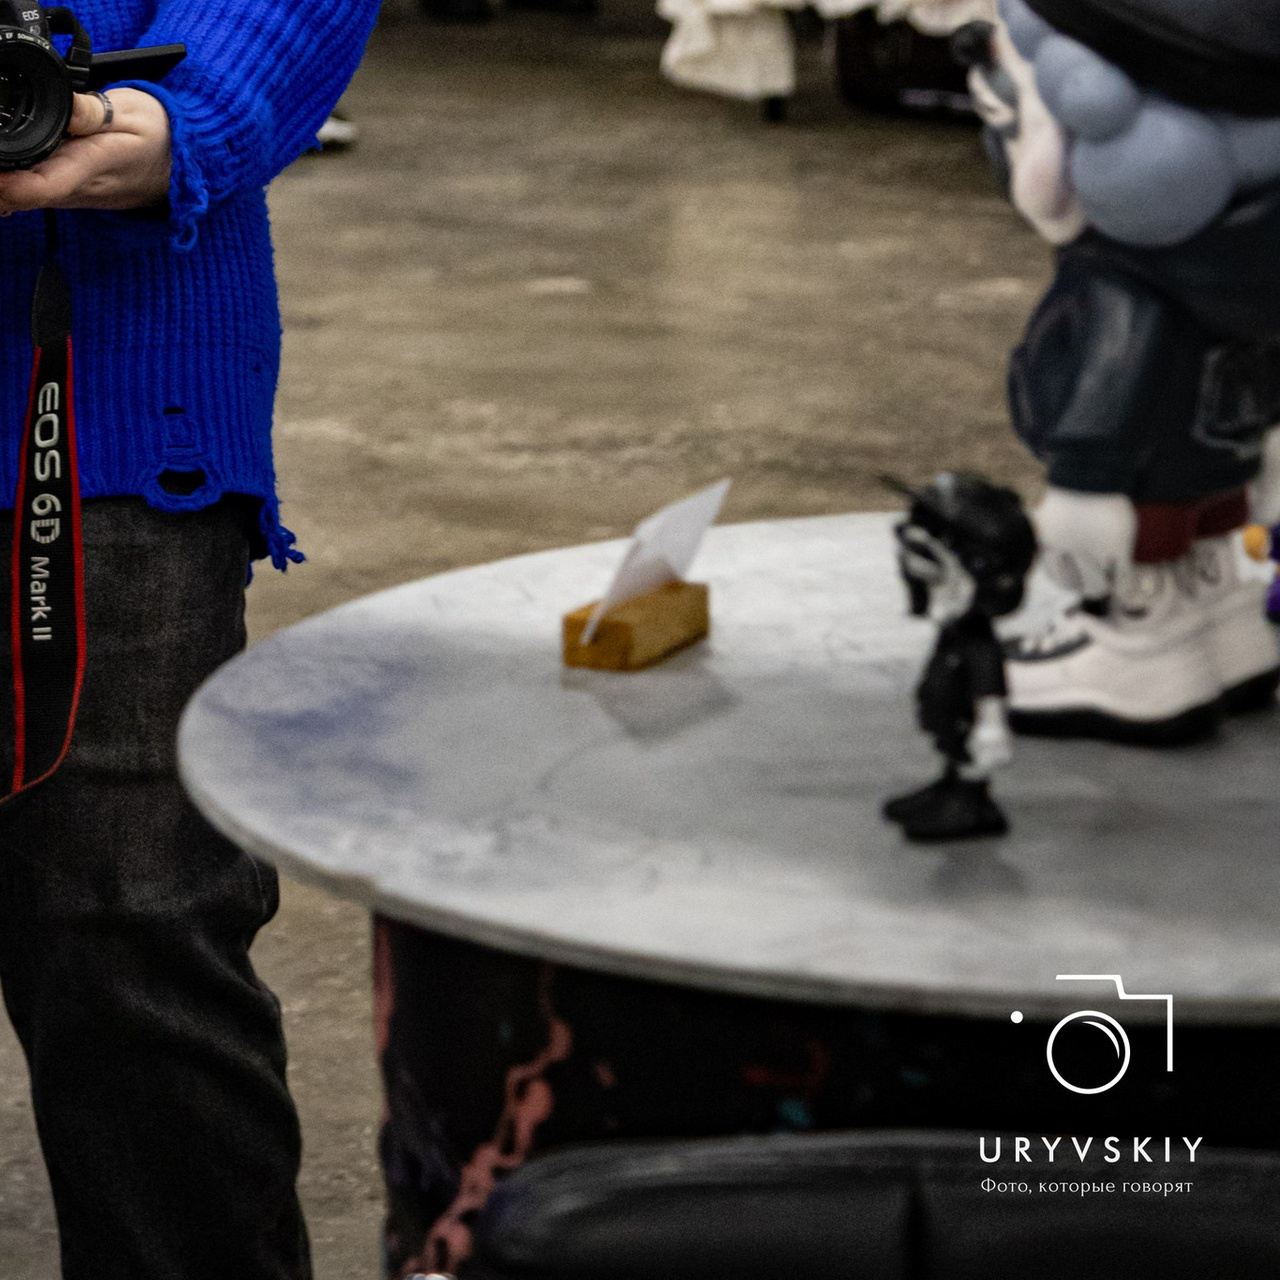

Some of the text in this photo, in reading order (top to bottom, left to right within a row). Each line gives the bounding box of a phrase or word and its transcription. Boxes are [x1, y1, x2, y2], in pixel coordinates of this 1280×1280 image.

[21, 9, 40, 21] EOS
[34, 381, 62, 482] EOS
[30, 493, 62, 544] 6D
[30, 556, 52, 622] Mark
